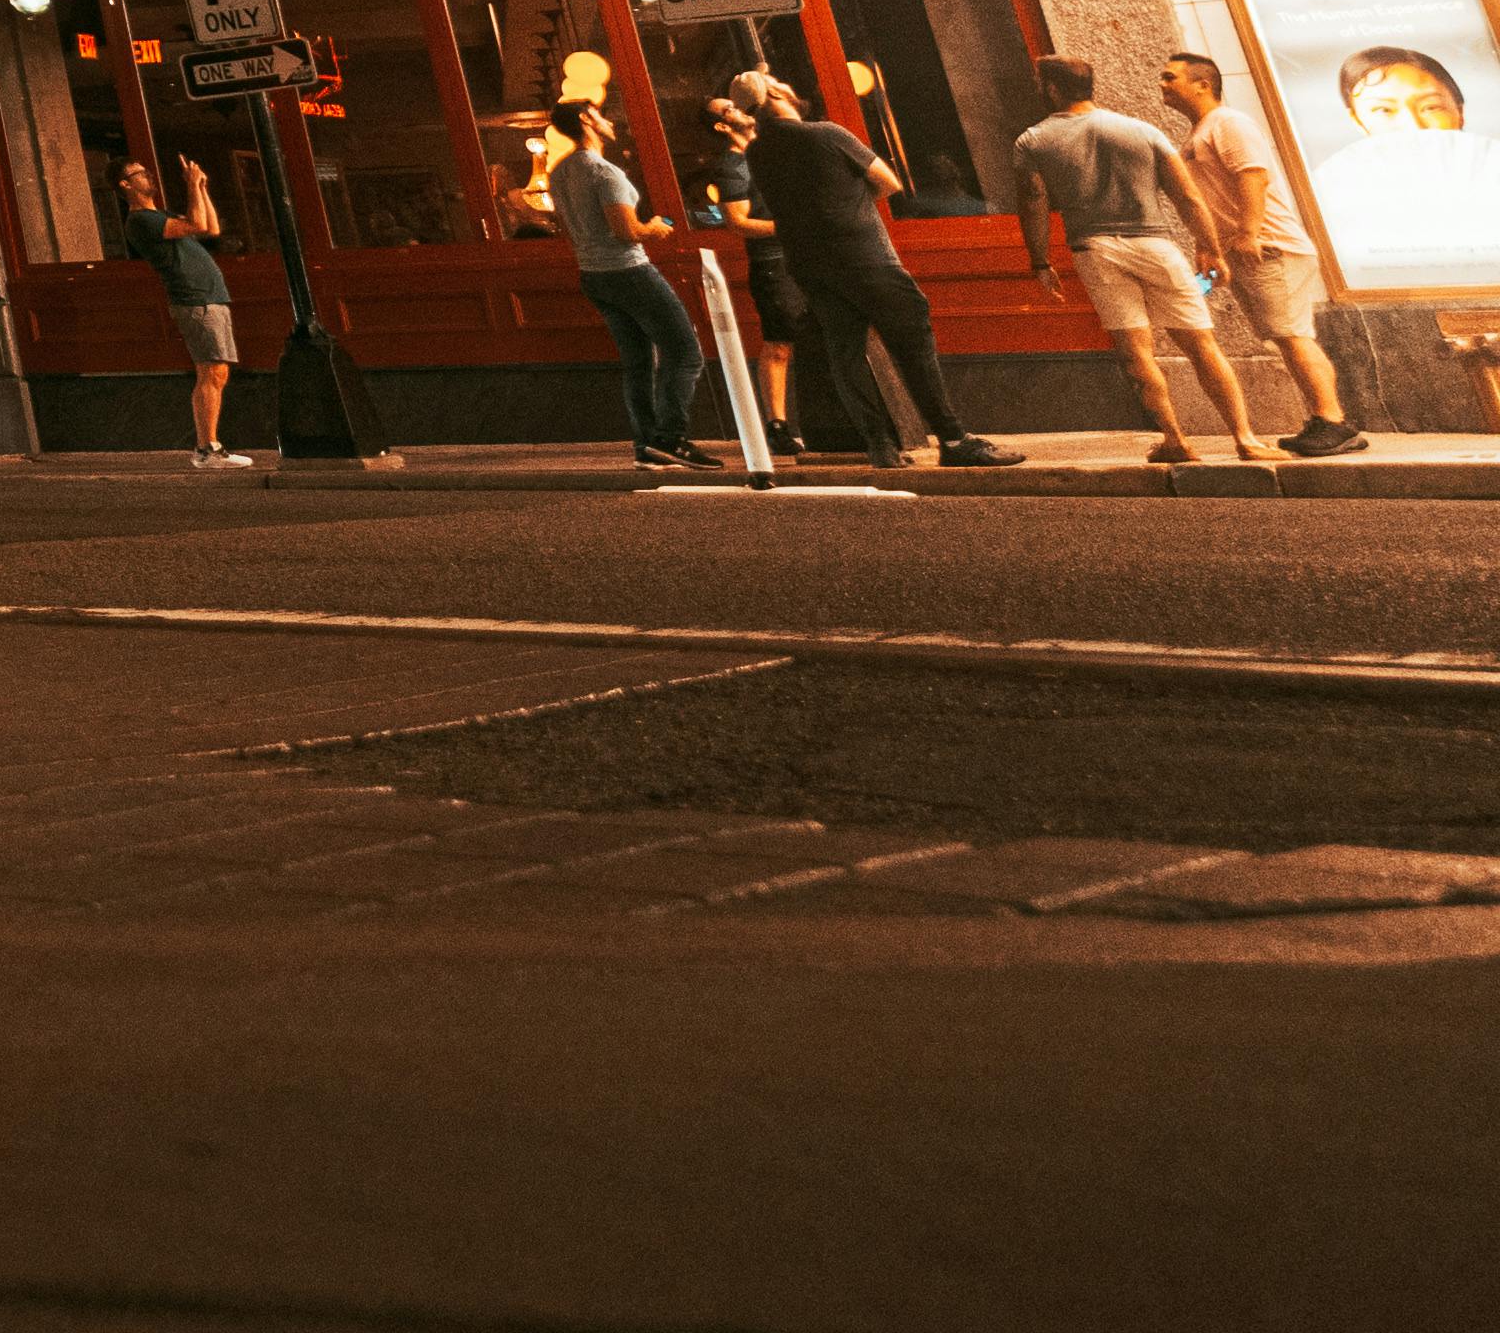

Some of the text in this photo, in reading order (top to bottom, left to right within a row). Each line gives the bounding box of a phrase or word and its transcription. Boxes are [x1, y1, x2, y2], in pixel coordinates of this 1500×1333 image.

[203, 6, 260, 33] ONLY
[198, 55, 275, 82] ONE WAY
